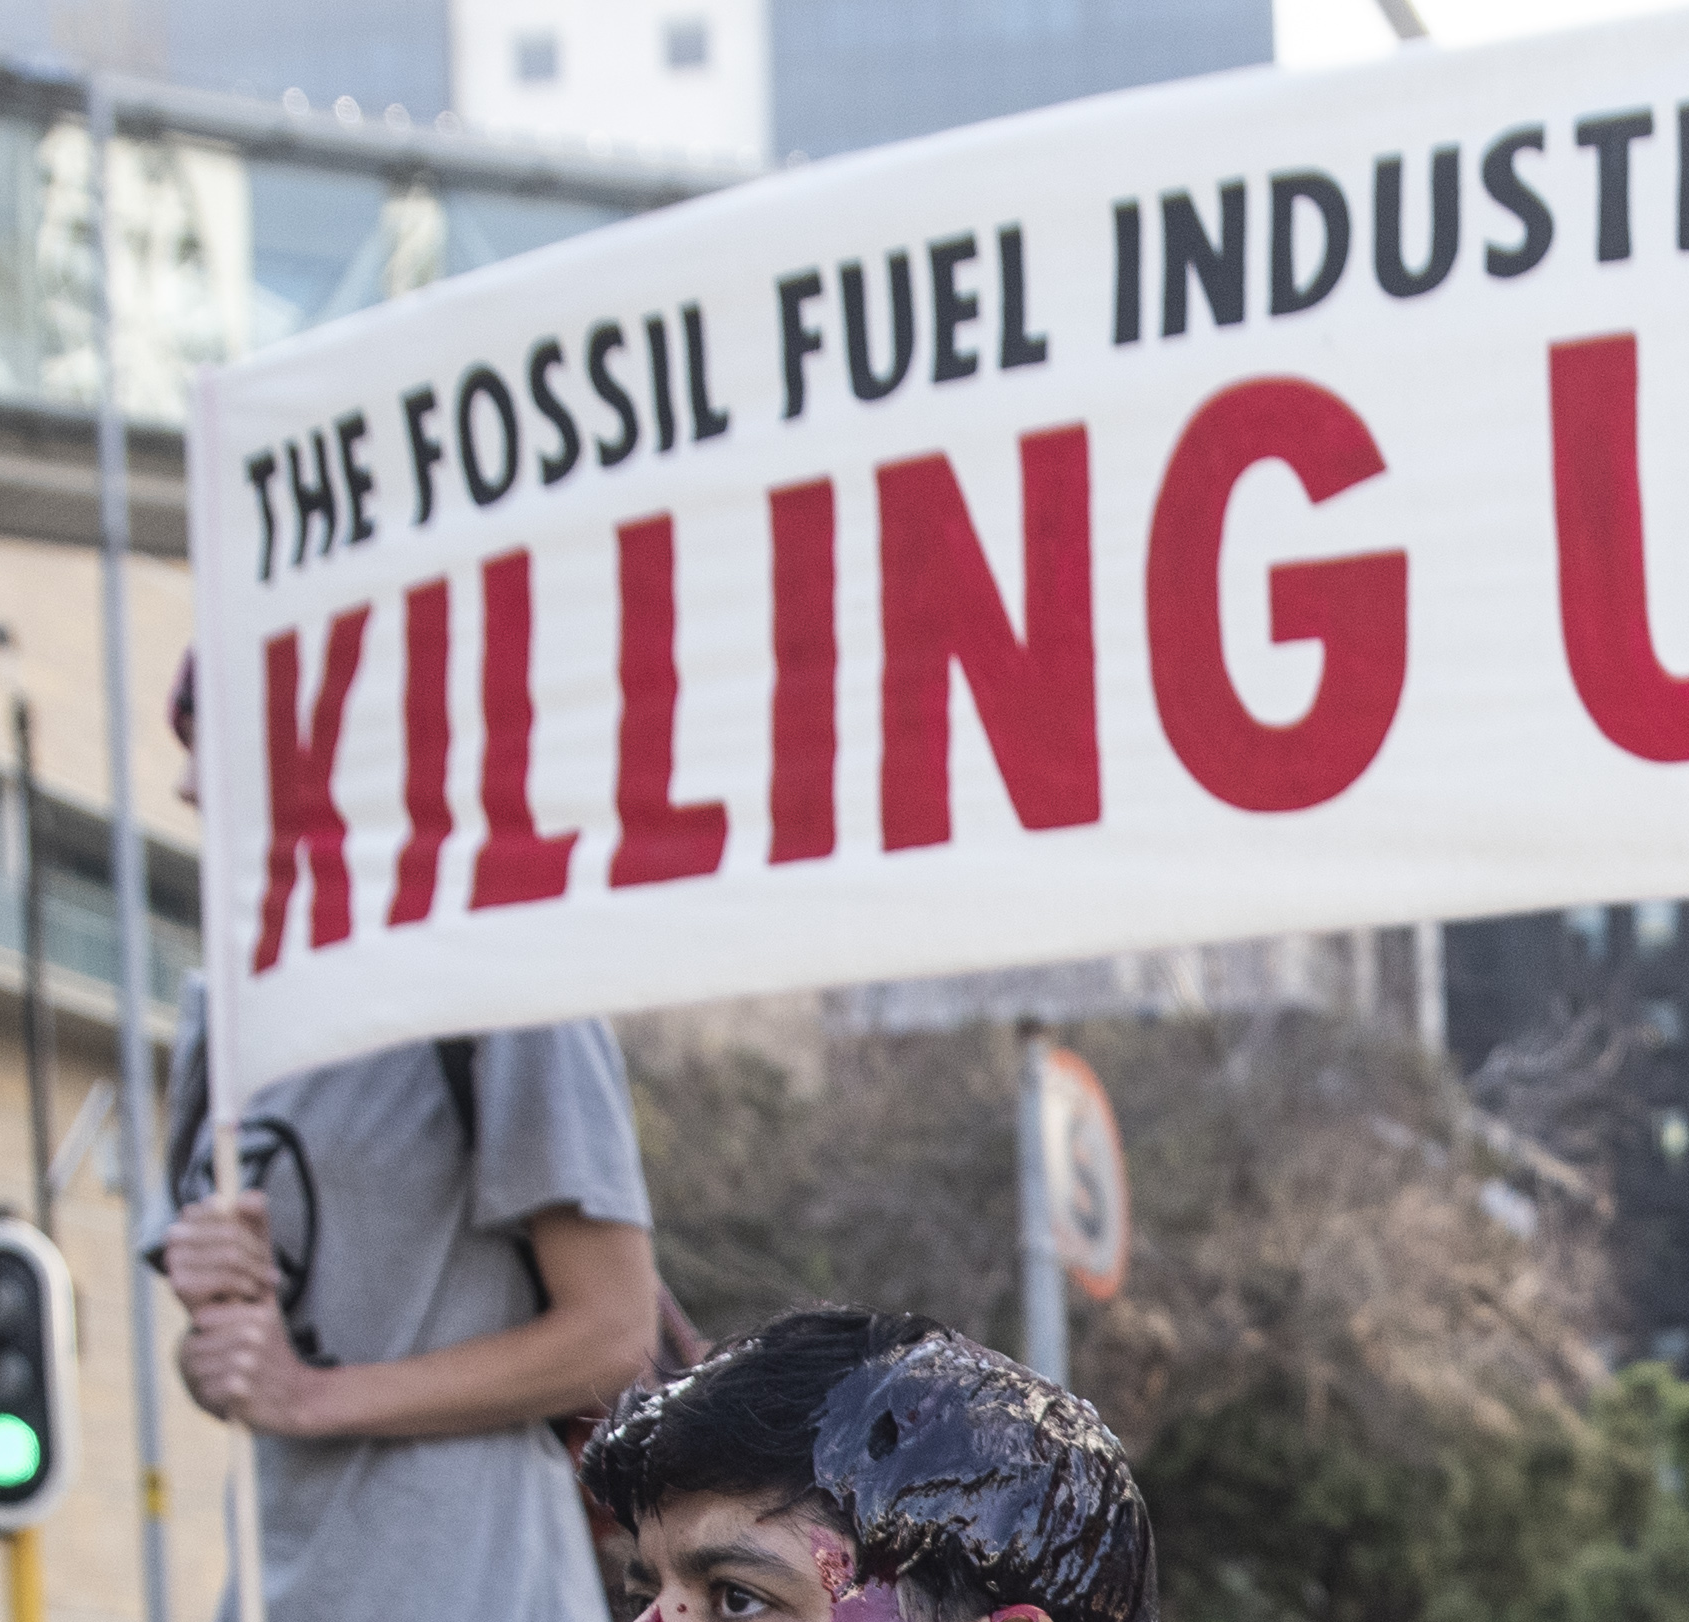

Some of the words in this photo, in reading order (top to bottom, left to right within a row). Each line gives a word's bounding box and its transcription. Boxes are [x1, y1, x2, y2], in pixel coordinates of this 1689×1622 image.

[247, 412, 375, 581] THE
[403, 302, 731, 510] FOSSIL
[775, 225, 1048, 417] FUEL
[250, 372, 1409, 975] KILLING
